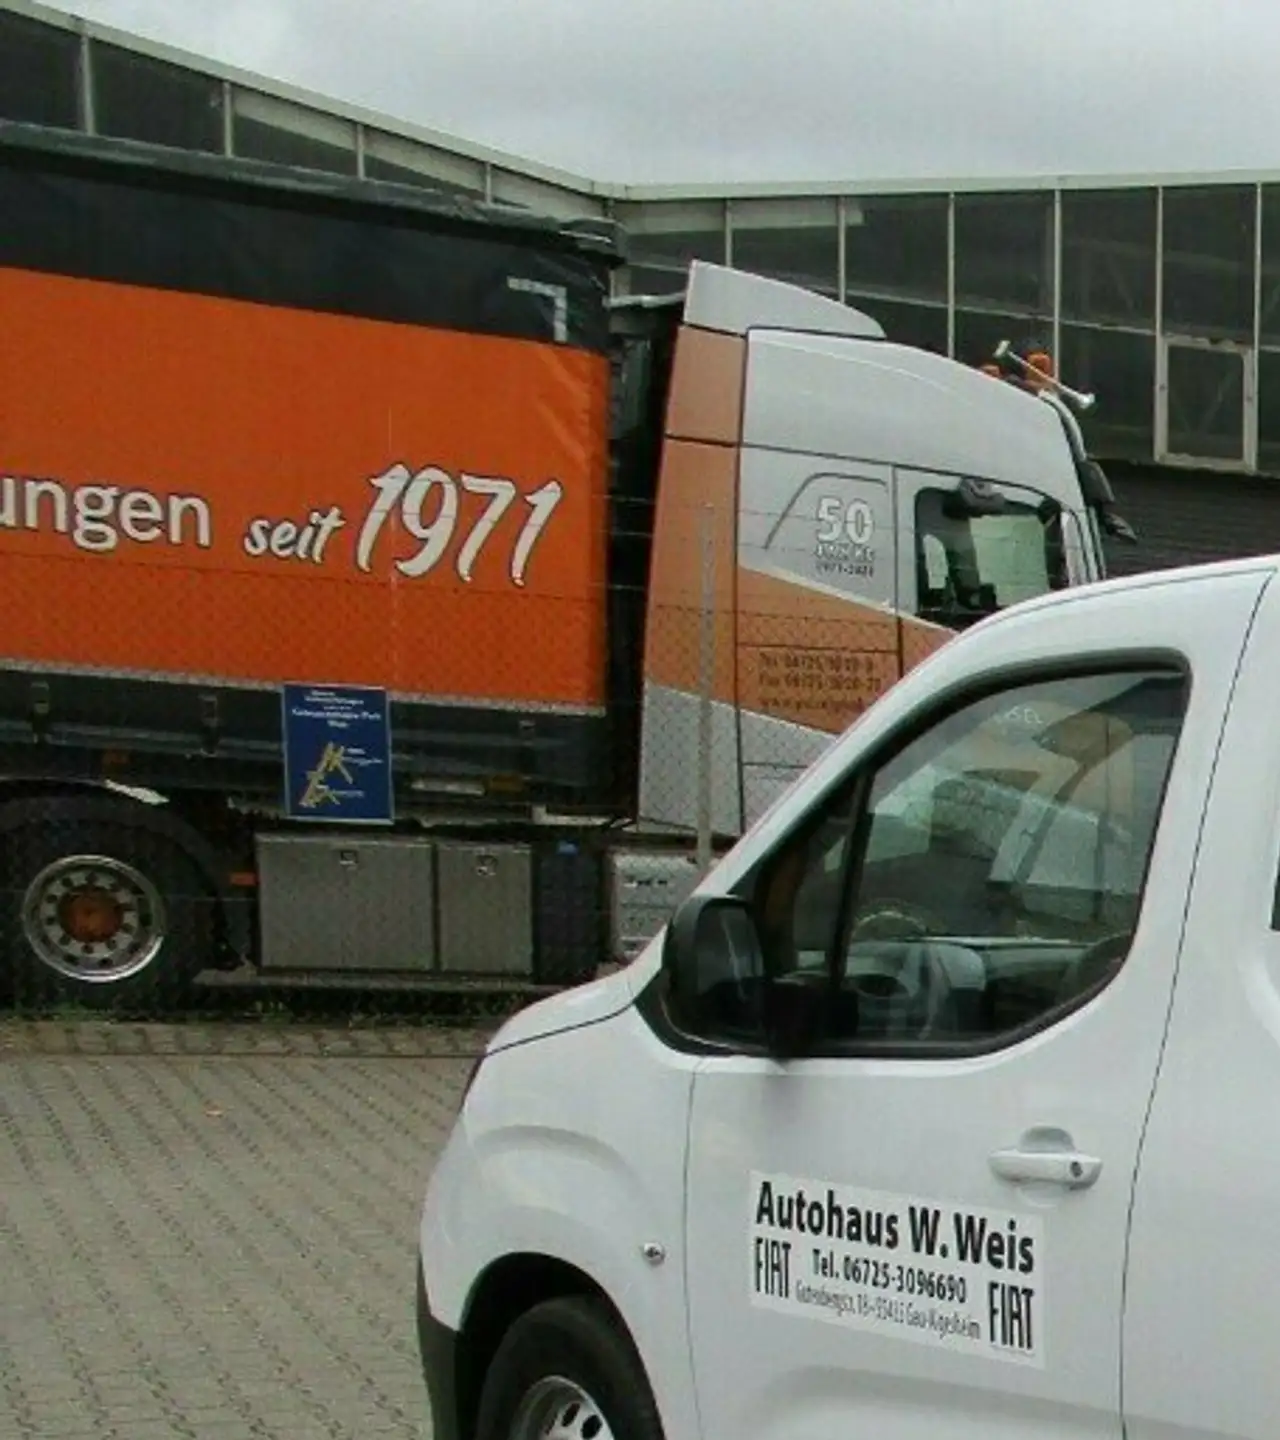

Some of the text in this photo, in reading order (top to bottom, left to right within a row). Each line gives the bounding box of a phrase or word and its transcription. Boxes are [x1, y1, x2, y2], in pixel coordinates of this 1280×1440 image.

[244, 506, 344, 563] seit
[353, 462, 562, 586] 1971
[816, 496, 874, 545] 50
[756, 1181, 899, 1250] Autohaus
[754, 1237, 791, 1299] FIAT
[812, 1248, 968, 1304] Tel. 06725-3096690
[987, 1281, 1035, 1350] FIAT
